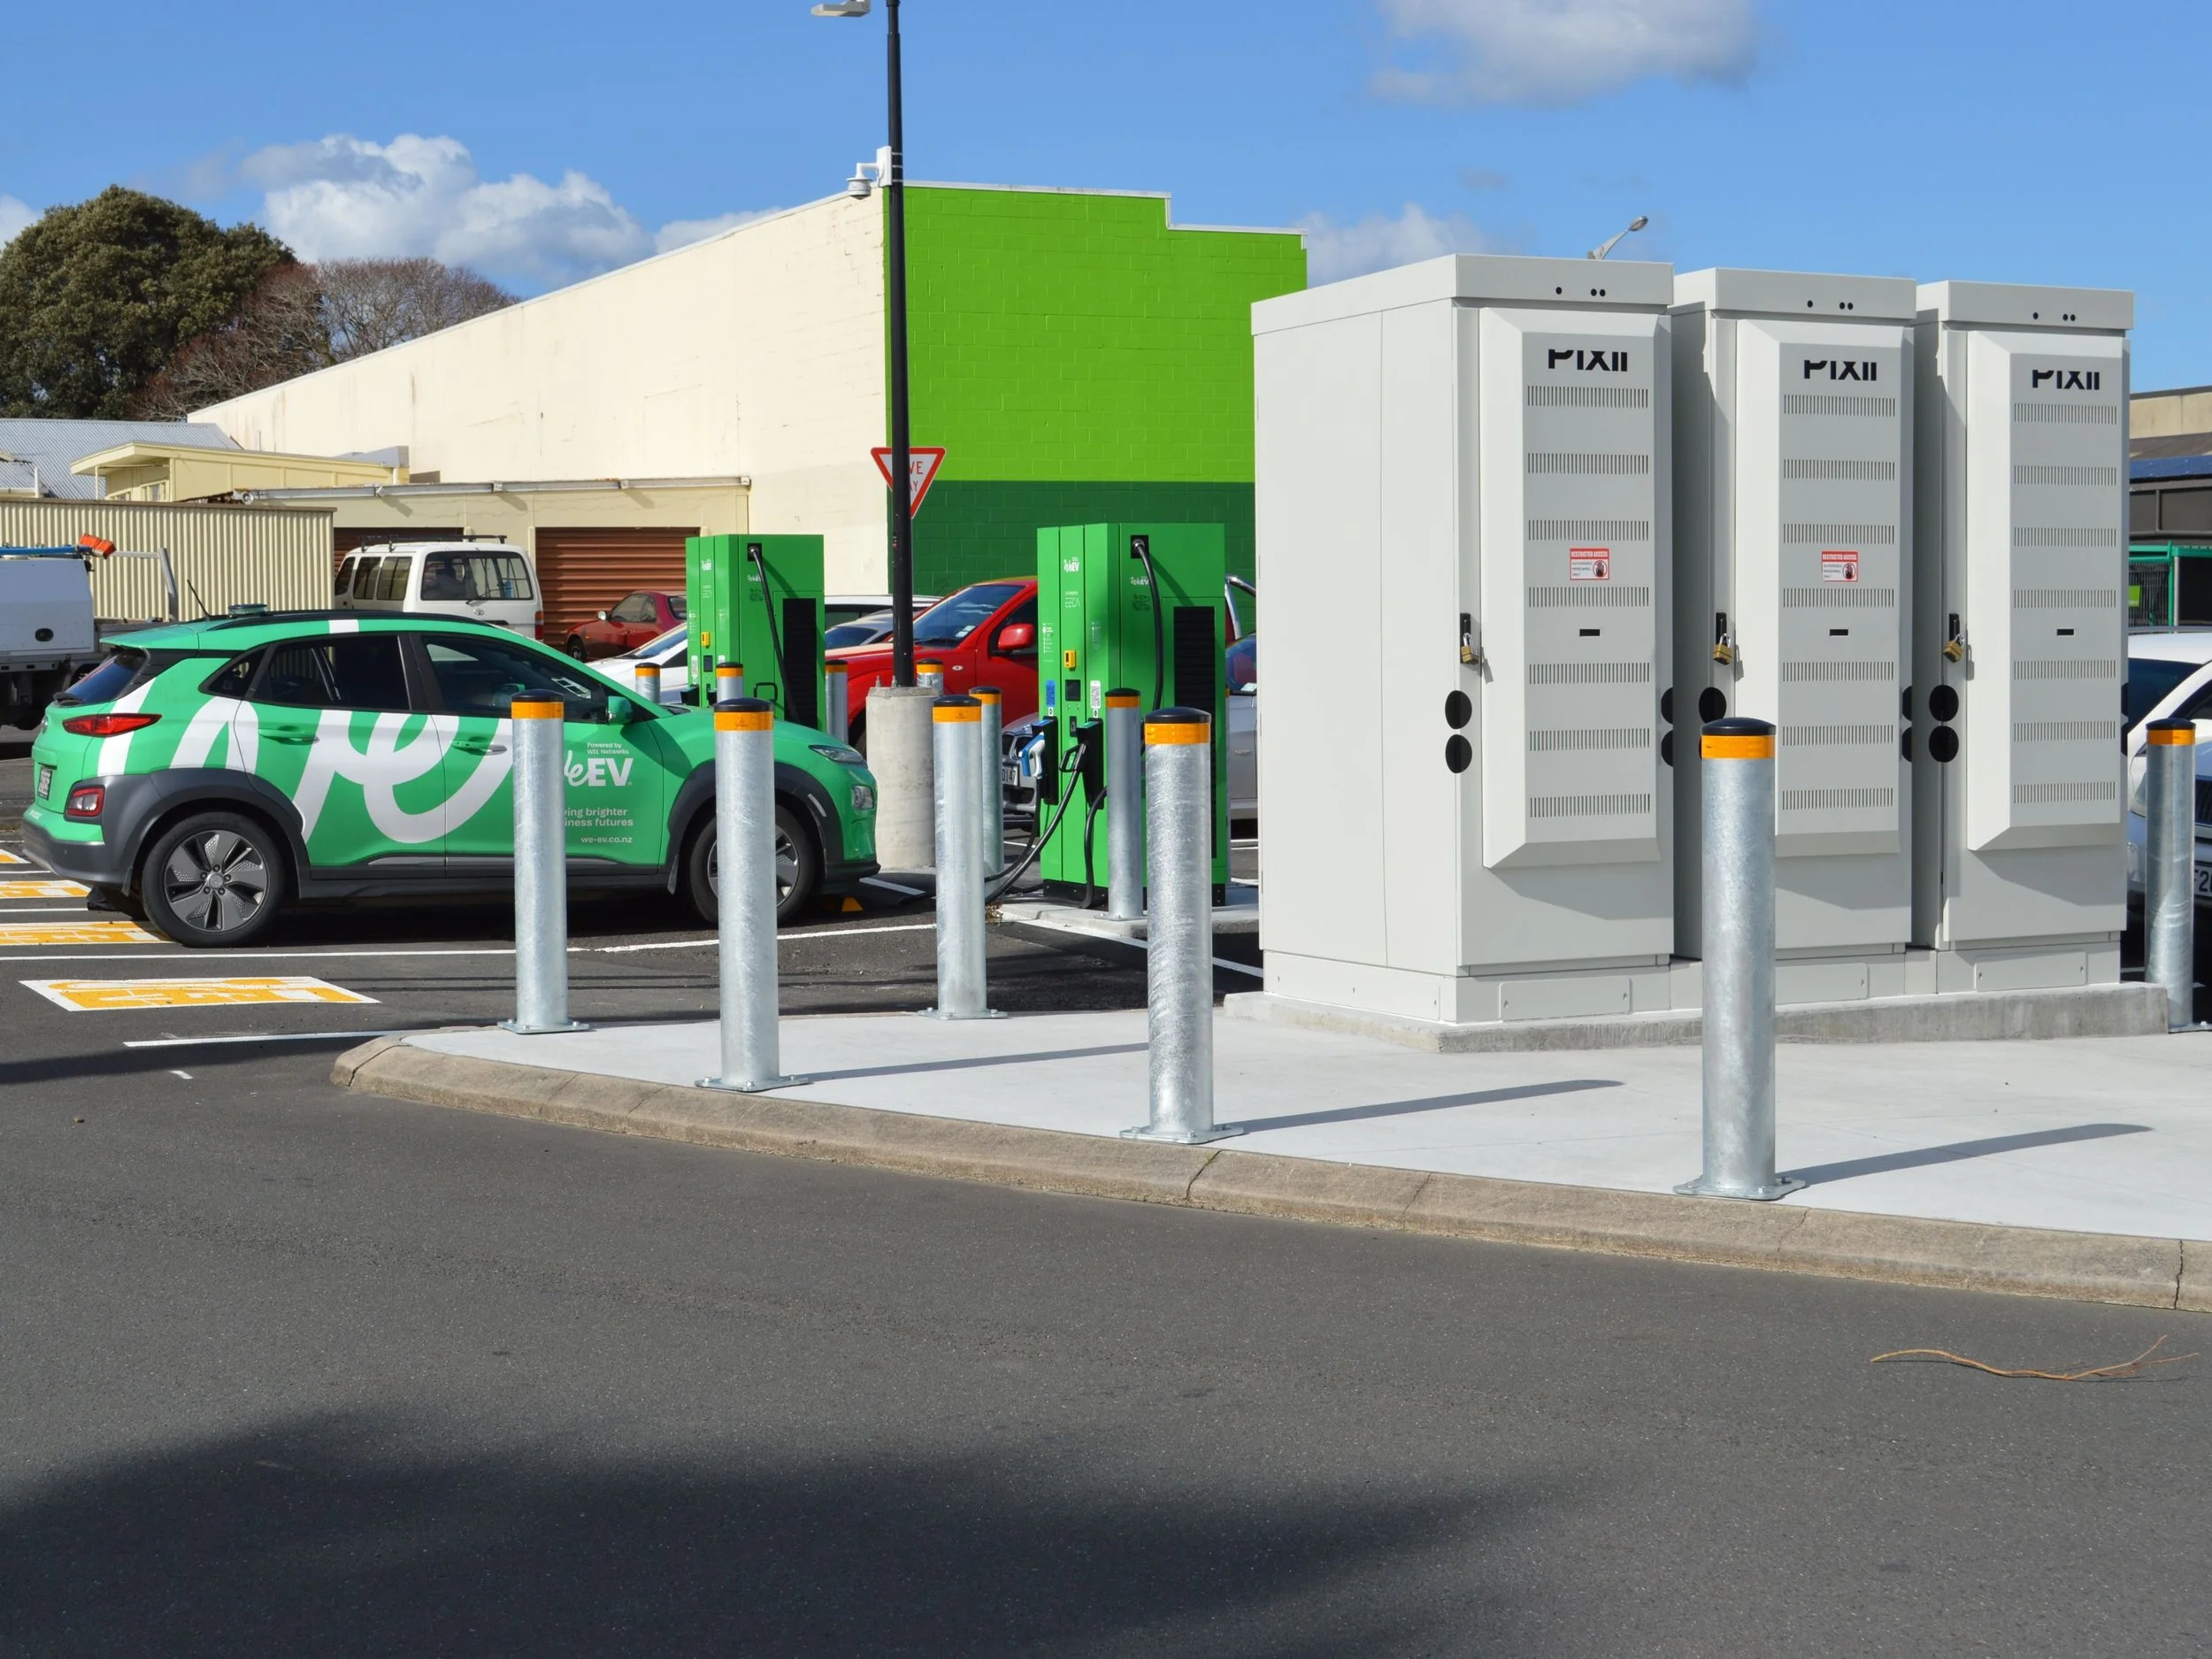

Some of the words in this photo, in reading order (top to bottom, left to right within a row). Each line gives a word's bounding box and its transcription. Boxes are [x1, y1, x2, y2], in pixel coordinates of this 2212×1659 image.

[1548, 349, 1628, 372] PIXII
[1803, 359, 1878, 381] PIXII
[2032, 369, 2101, 390] PIXII
[910, 461, 924, 475] VE
[586, 807, 628, 818] brighter
[565, 818, 593, 826] iness
[595, 818, 634, 826] futures
